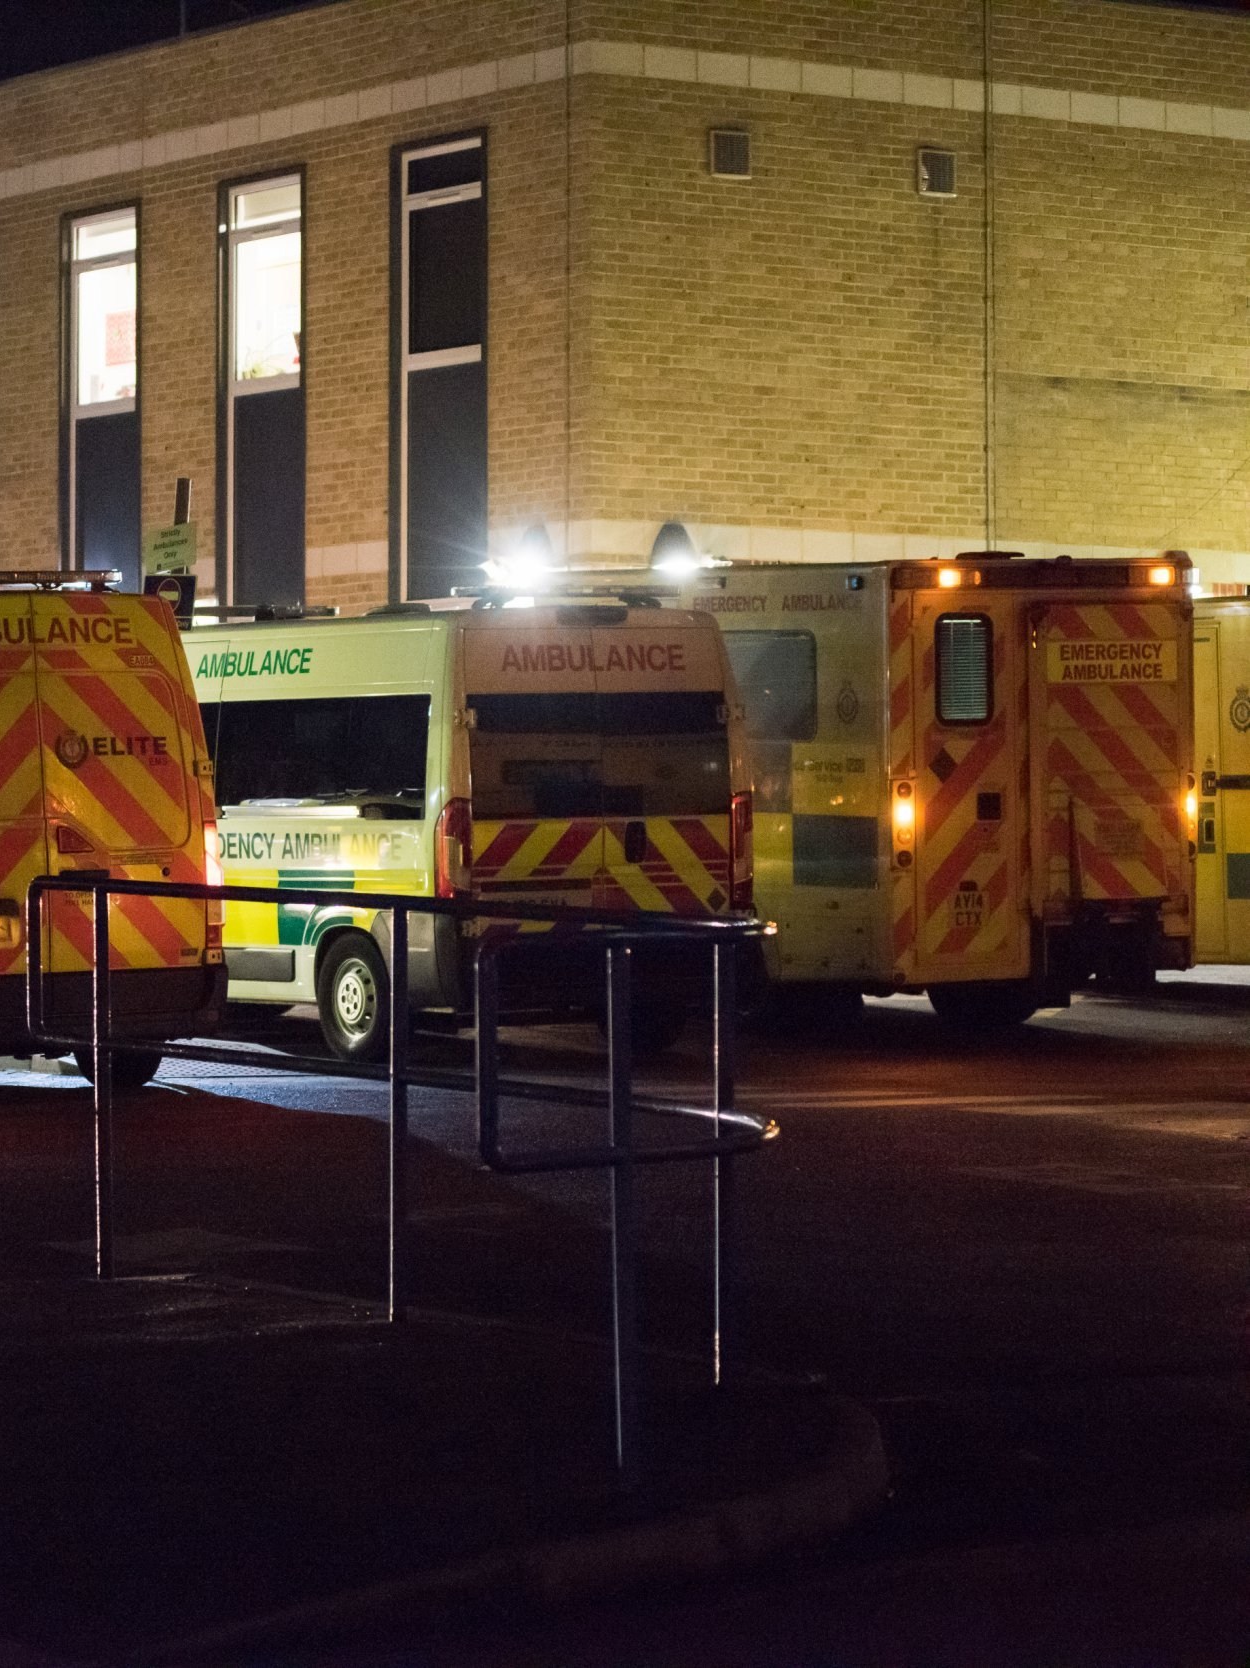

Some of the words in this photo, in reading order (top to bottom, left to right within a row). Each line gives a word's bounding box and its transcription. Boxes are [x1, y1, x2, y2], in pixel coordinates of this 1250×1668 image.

[501, 644, 686, 672] AMBULANCE
[1060, 643, 1163, 661] EMERGENCY
[196, 648, 313, 679] AMBULANCE
[1062, 663, 1163, 680] AMBULANCE
[92, 736, 168, 756] ELITE
[150, 758, 168, 766] EMS
